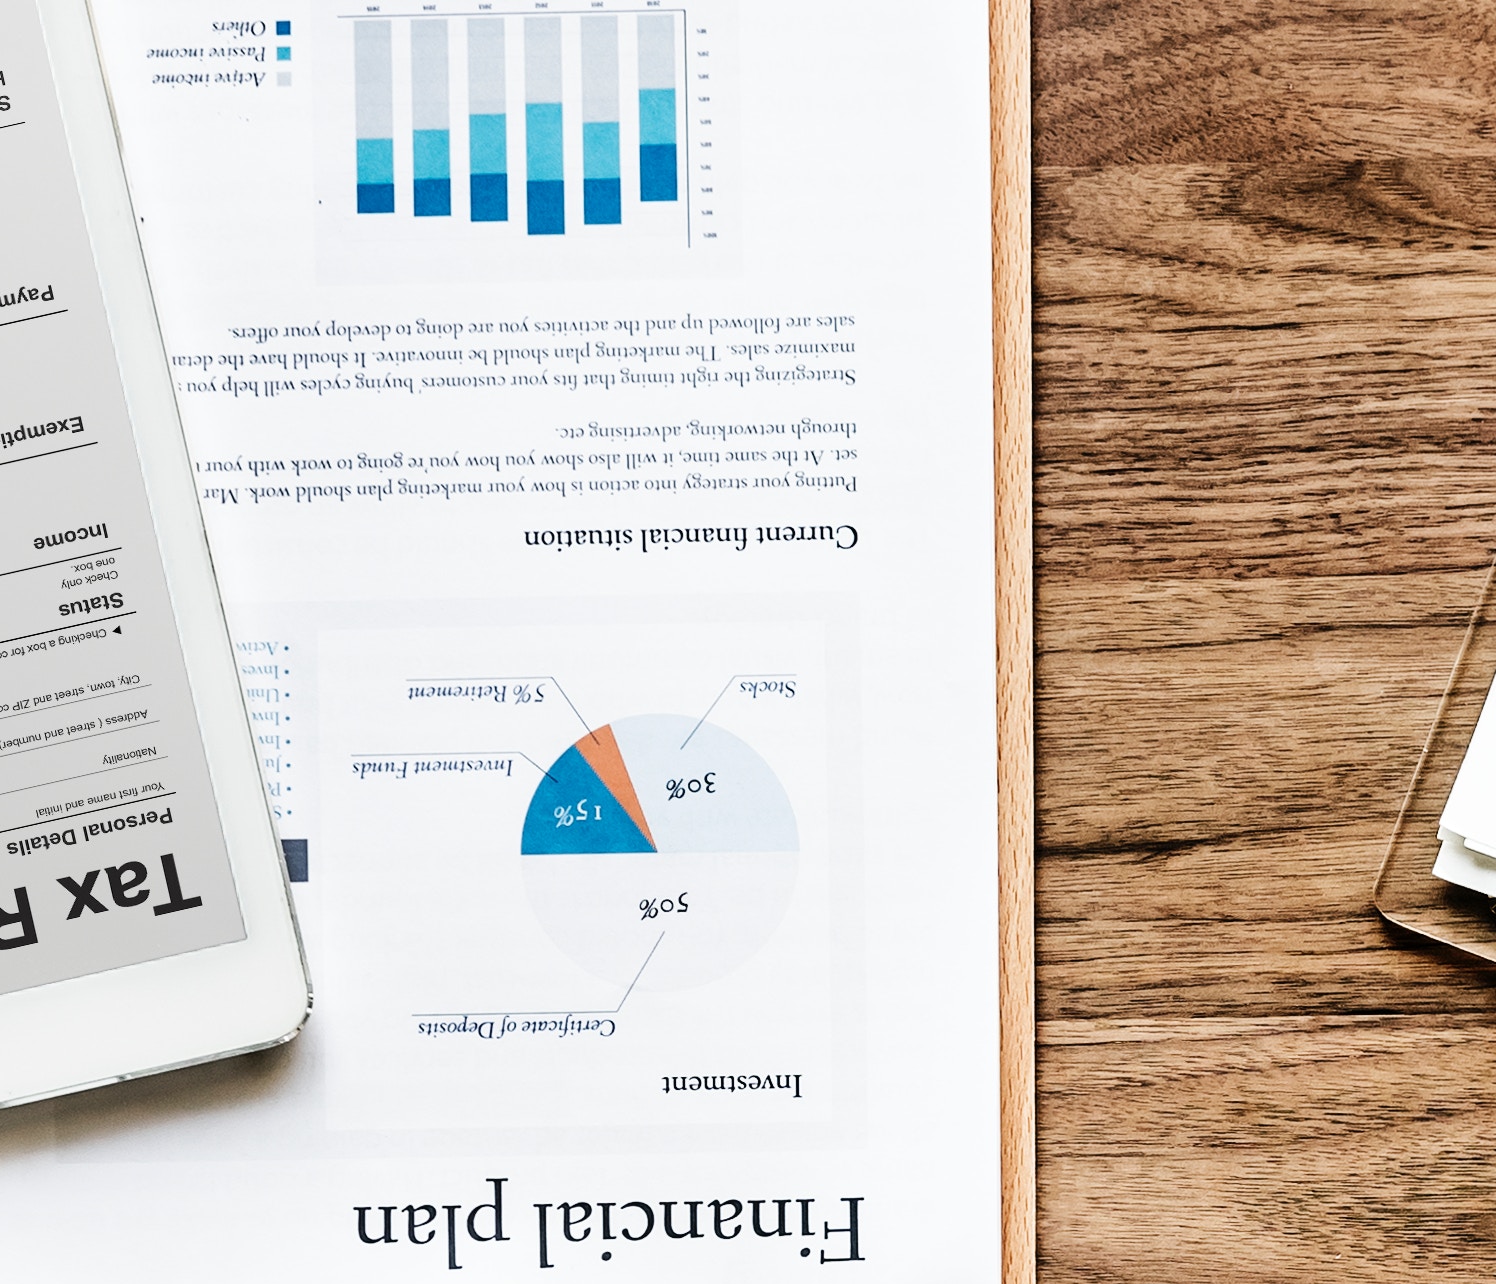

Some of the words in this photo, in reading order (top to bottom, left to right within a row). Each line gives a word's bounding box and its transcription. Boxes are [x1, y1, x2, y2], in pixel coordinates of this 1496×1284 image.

[212, 21, 266, 39] Others
[147, 47, 204, 59] income
[208, 46, 267, 62] Passive
[152, 73, 209, 88] income
[215, 69, 266, 87] Active
[33, 523, 109, 550] Income
[524, 529, 632, 552] situation
[641, 527, 747, 553] financial
[756, 525, 858, 550] Current
[58, 592, 124, 616] Status
[408, 686, 507, 703] Retirement
[513, 683, 545, 705] 5%
[740, 681, 796, 698] Stocks
[102, 746, 157, 765] Nationality
[352, 761, 408, 780] Funds
[414, 759, 513, 777] Investment
[666, 772, 716, 801] 30%
[553, 796, 604, 828] 15%
[82, 807, 173, 842] Personal
[6, 829, 77, 856] Details
[55, 852, 204, 921] Tax
[639, 891, 689, 920] 50%
[418, 1016, 494, 1039] Deposits
[497, 1016, 517, 1039] of
[522, 1016, 616, 1038] Certificate
[662, 1074, 802, 1098] Investment
[352, 1177, 512, 1271] plan
[532, 1196, 867, 1269] Financial
